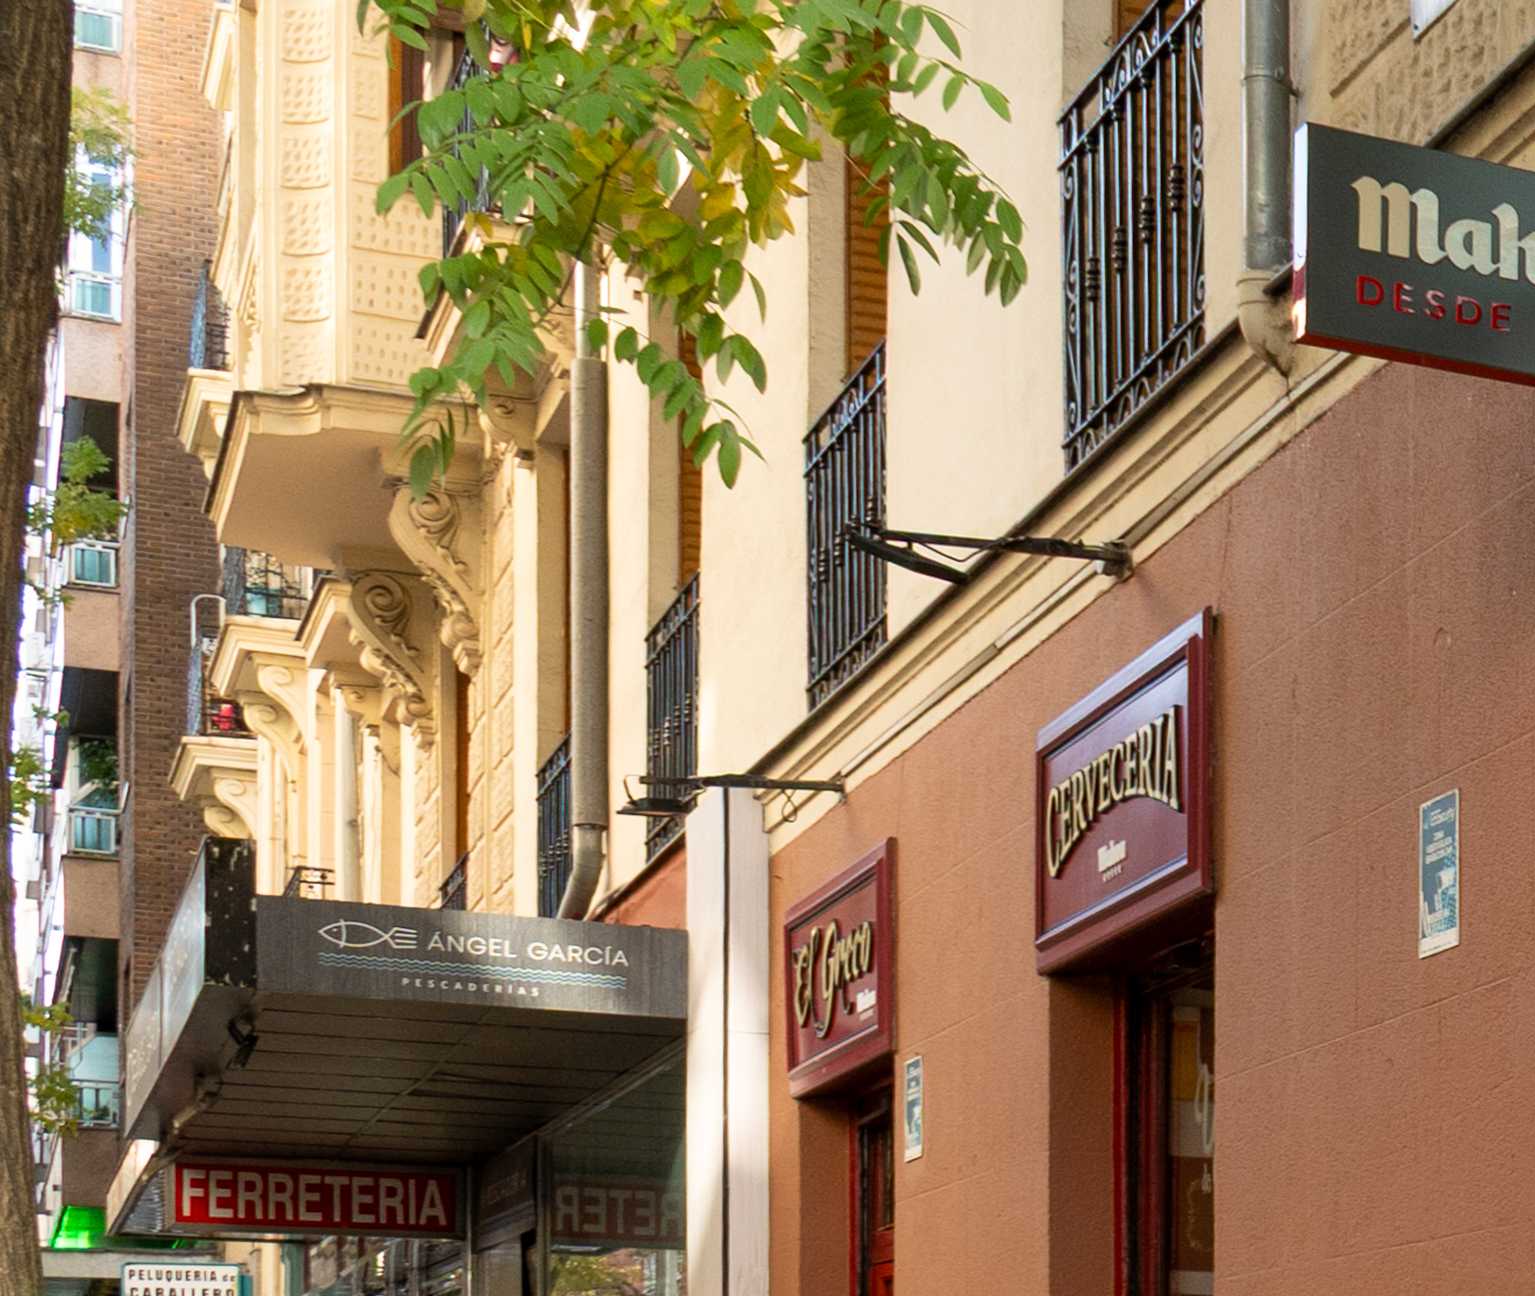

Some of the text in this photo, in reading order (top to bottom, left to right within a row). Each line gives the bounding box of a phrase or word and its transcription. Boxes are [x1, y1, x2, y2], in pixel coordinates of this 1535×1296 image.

[1356, 275, 1512, 333] DESDE
[1043, 704, 1182, 880] CERVECERIA
[427, 930, 630, 968] ÁNGEL GARCÍA
[793, 917, 873, 1039] El Greco
[401, 976, 541, 998] PESCADERÍAS
[180, 1167, 449, 1228] FERRETERIA
[128, 1269, 218, 1282] PELUQUERIA
